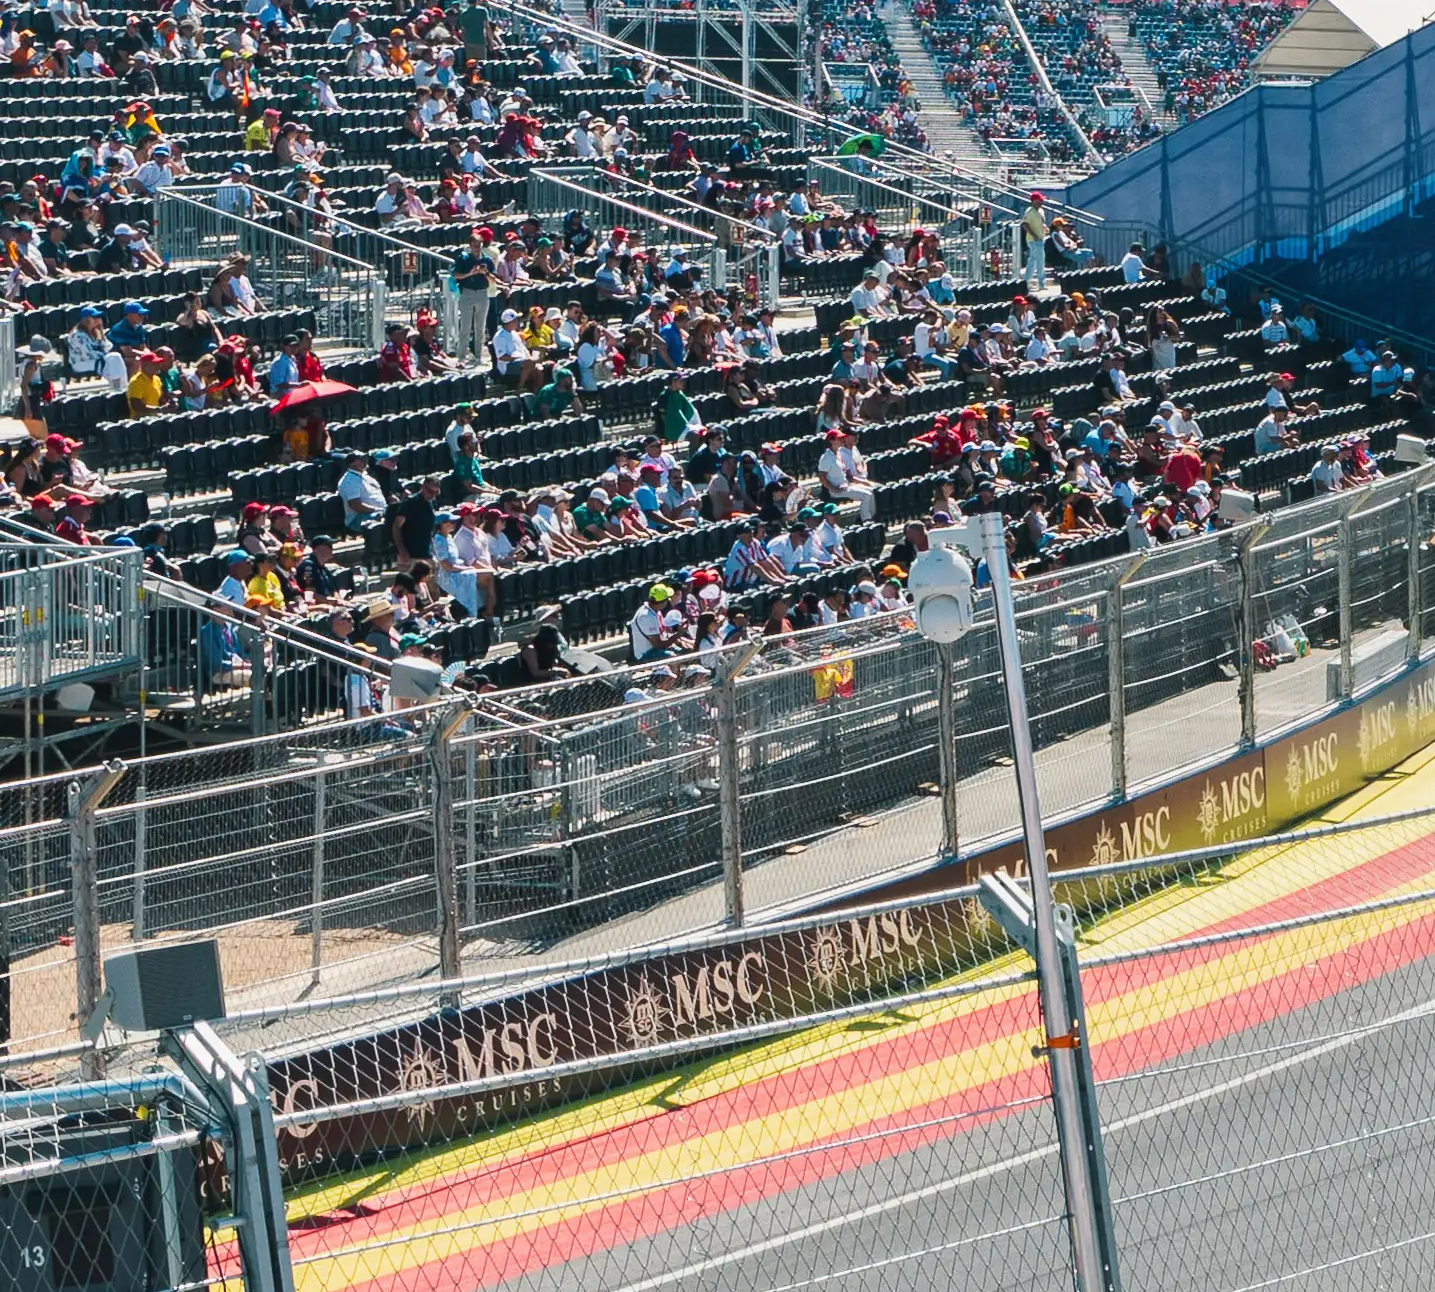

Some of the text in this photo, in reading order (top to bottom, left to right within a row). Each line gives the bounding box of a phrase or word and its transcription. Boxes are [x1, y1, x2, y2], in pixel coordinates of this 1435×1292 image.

[1370, 701, 1396, 749] MSC
[1303, 732, 1338, 785] MSC
[1220, 766, 1265, 823] MSC
[1305, 779, 1340, 805] CRUISES
[1120, 806, 1170, 860] MSC
[1223, 814, 1267, 843] CRUISES
[850, 907, 923, 966] MSC
[672, 952, 764, 1025] MSC
[453, 1012, 559, 1082] MSC
[456, 1076, 562, 1122] CRUISES
[21, 1245, 45, 1268] 13
